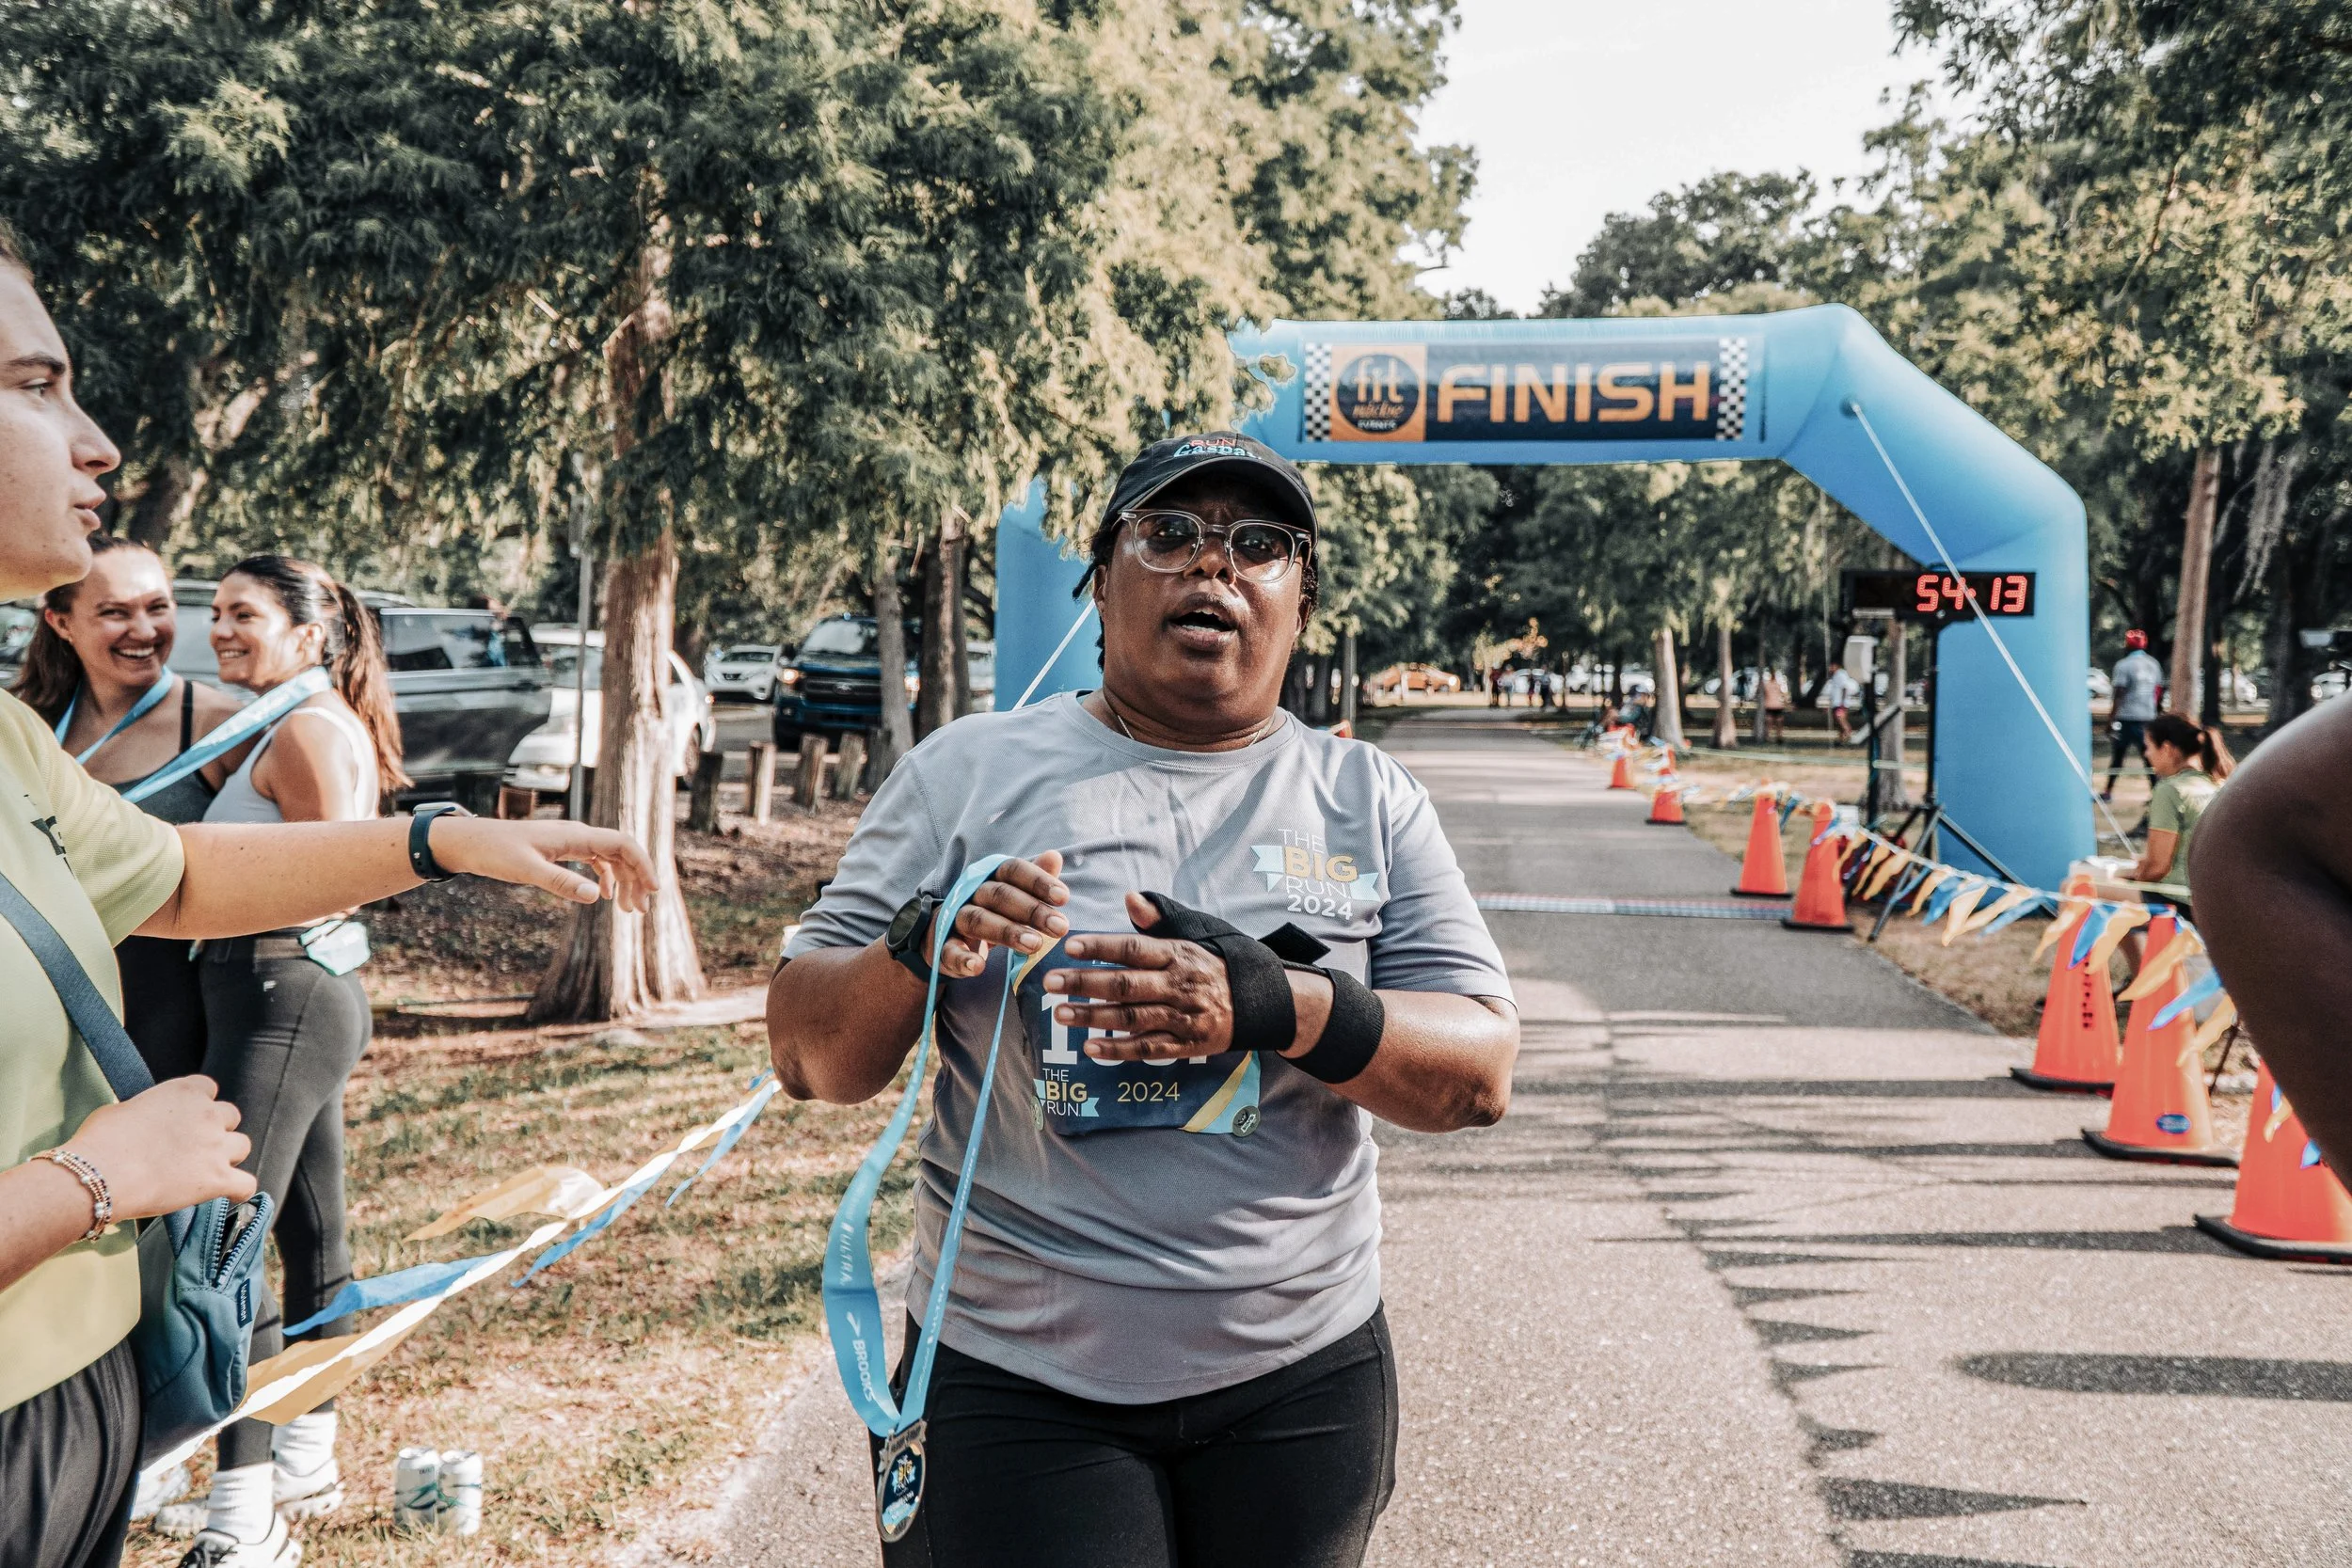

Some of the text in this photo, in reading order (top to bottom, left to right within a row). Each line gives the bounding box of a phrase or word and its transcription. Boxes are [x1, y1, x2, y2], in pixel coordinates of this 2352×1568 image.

[1352, 357, 1405, 403] fit
[1437, 361, 1710, 423] FINISH
[1279, 829, 1325, 854] THE
[1284, 847, 1359, 882] BIG
[1287, 894, 1353, 921] 2024
[1042, 1068, 1070, 1082] THE
[1045, 1080, 1088, 1102] BIG
[1117, 1082, 1181, 1102] 2024
[851, 1338, 873, 1402] BROOKS
